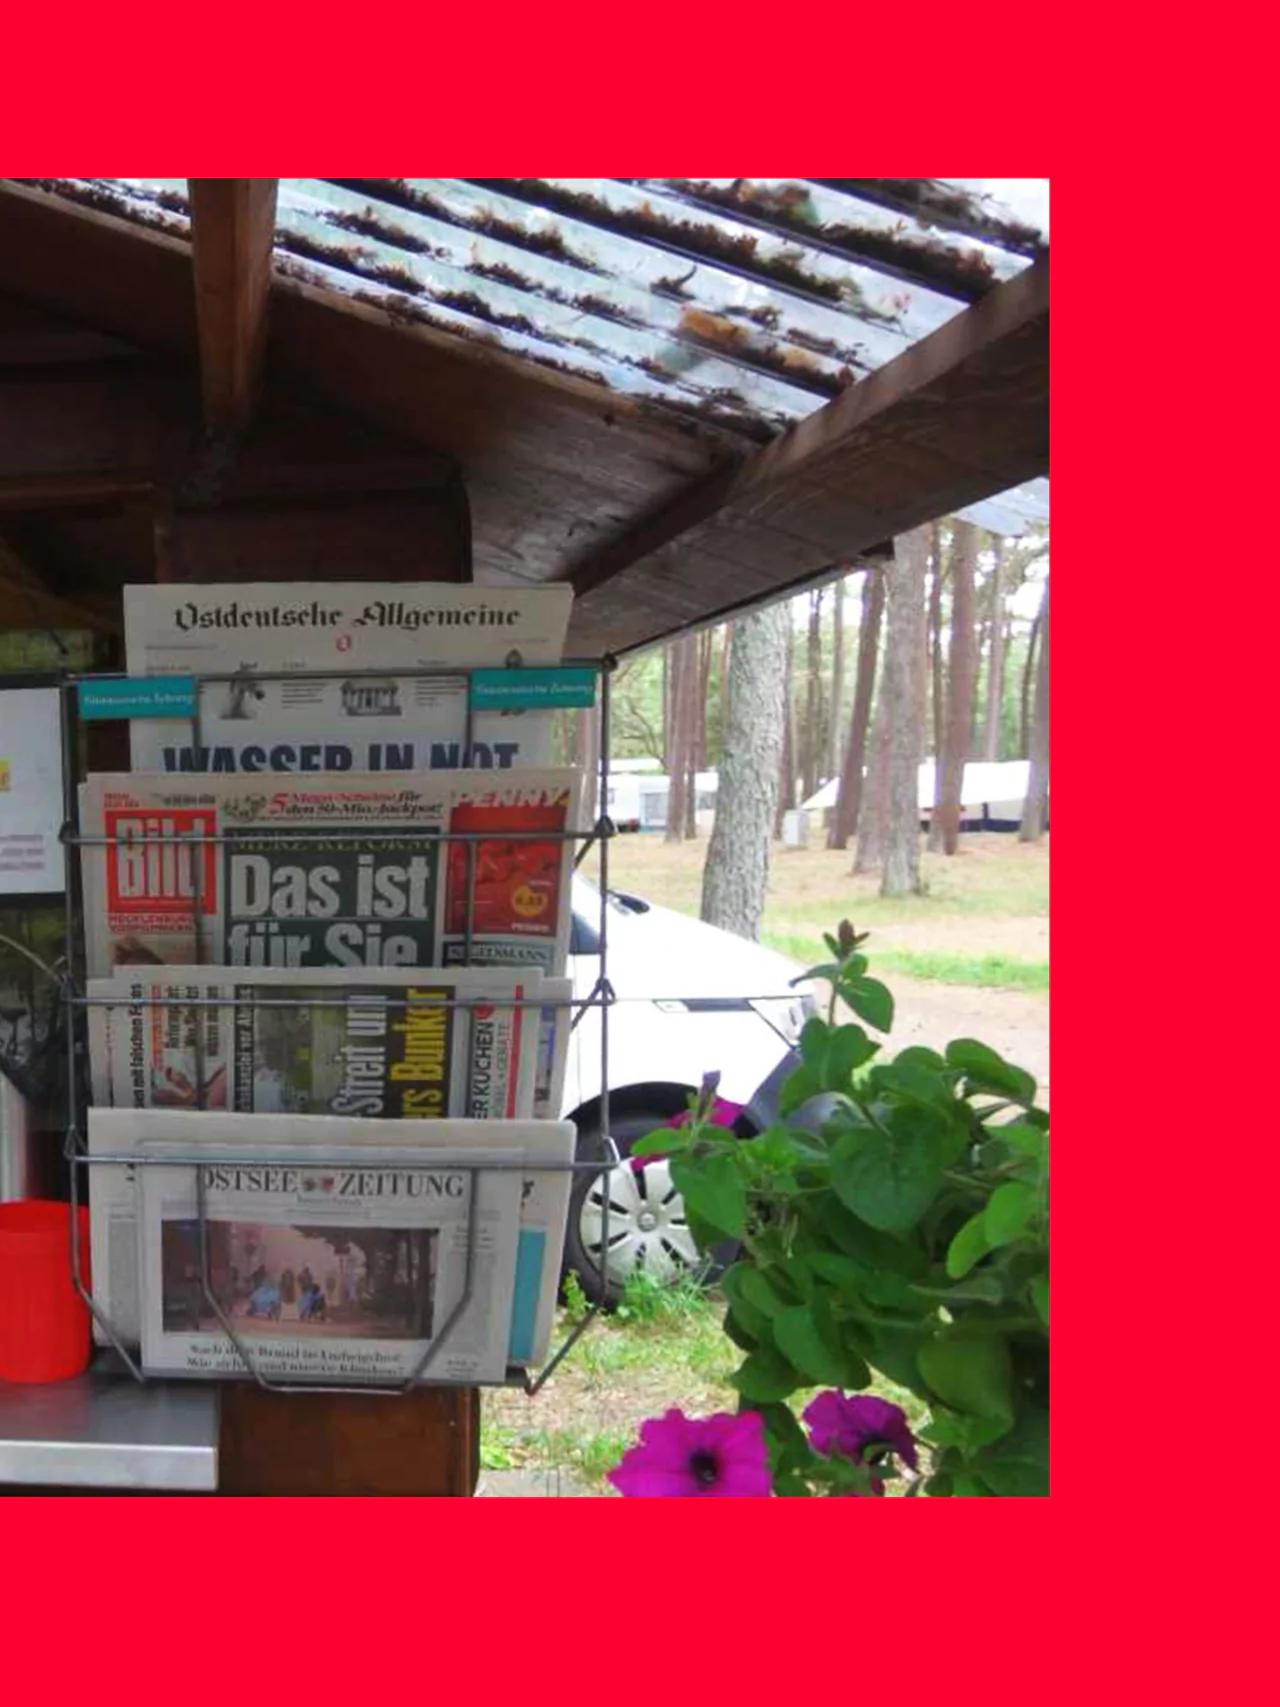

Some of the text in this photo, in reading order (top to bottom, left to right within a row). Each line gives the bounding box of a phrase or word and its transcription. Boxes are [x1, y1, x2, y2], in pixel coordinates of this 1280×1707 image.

[174, 600, 521, 631] Ostdeutsche Allgemeine
[368, 743, 415, 772] IN
[430, 742, 520, 771] NOT
[115, 818, 206, 898] Bild
[231, 853, 430, 918] Das ist
[228, 922, 312, 967] für
[324, 922, 418, 968] Sie
[338, 1172, 464, 1198] ZEITUNG
